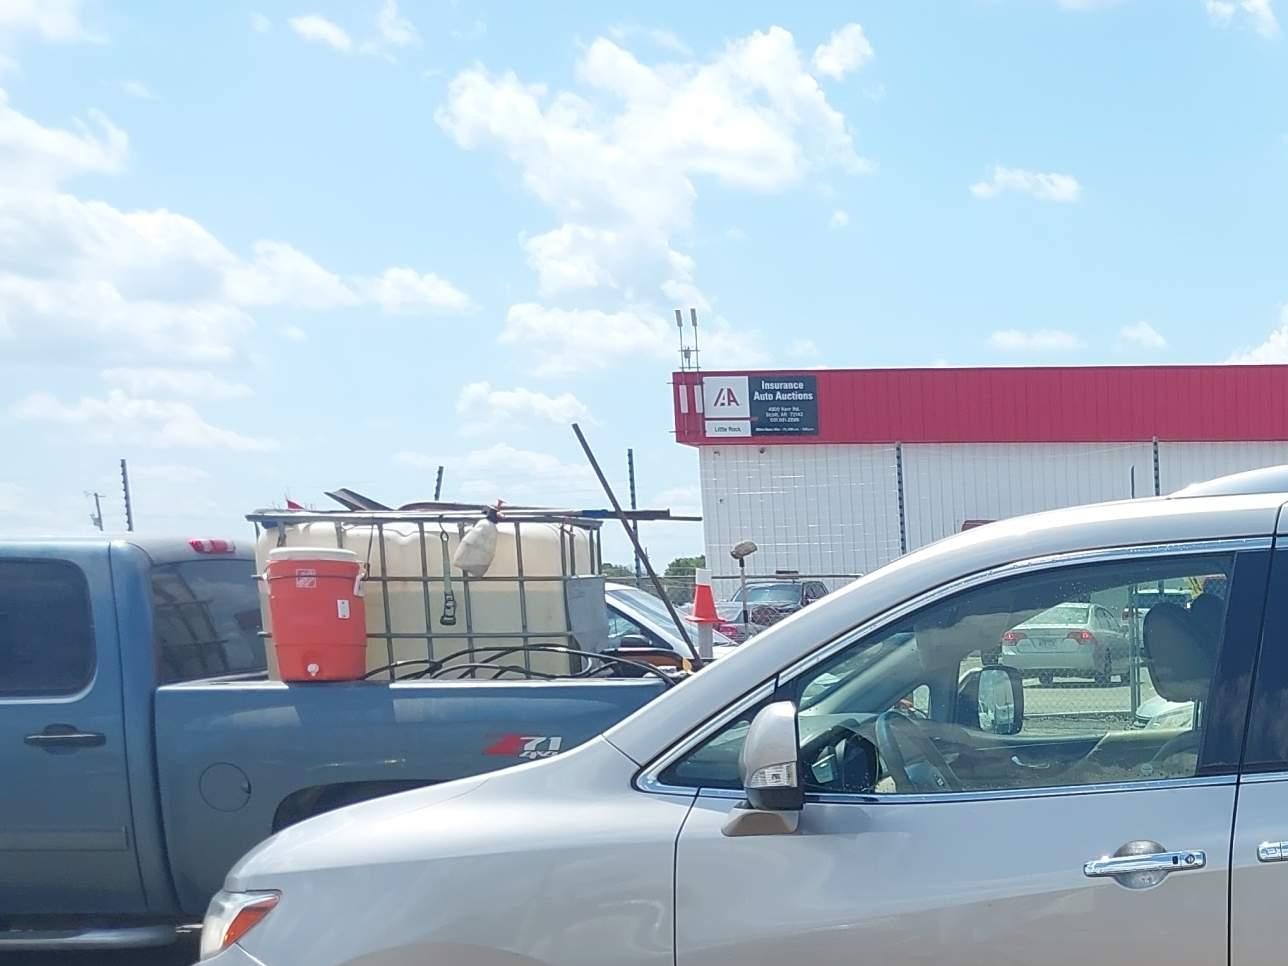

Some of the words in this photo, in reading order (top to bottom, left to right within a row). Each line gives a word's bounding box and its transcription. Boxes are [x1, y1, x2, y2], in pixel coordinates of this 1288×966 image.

[761, 380, 804, 390] Insurance
[753, 391, 774, 401] Auto
[776, 391, 813, 401] Auctions
